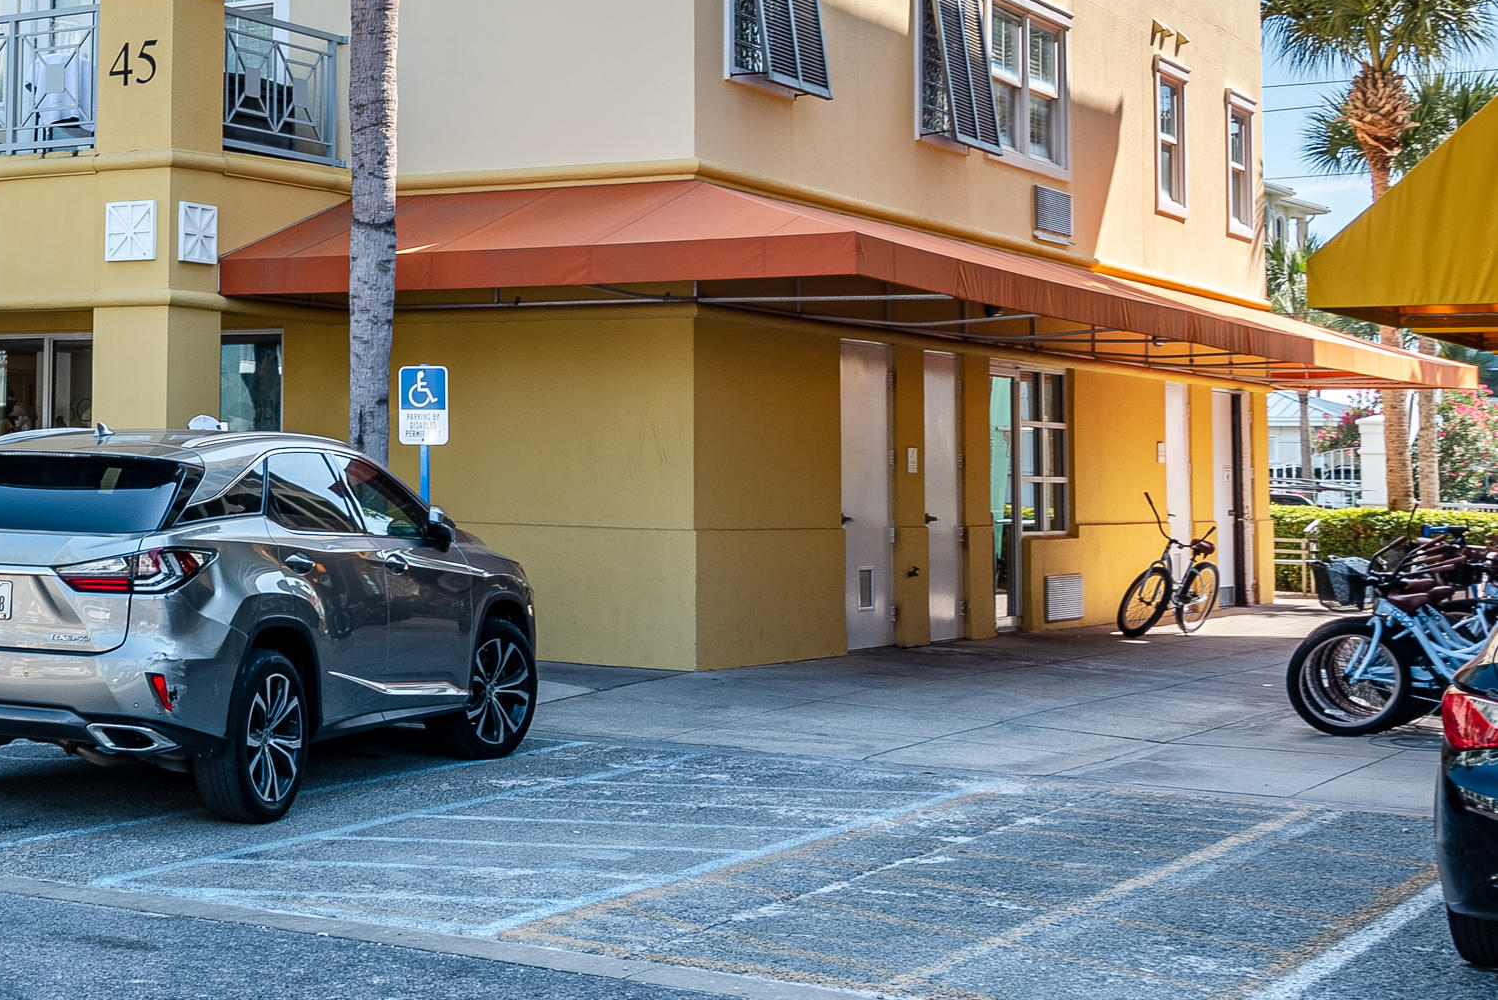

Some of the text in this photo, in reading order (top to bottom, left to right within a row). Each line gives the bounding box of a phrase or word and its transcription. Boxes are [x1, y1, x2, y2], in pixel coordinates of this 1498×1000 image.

[109, 39, 158, 86] 45
[406, 413, 440, 421] PARKING BY
[409, 421, 437, 430] DISABLED
[405, 429, 425, 438] PERMIT
